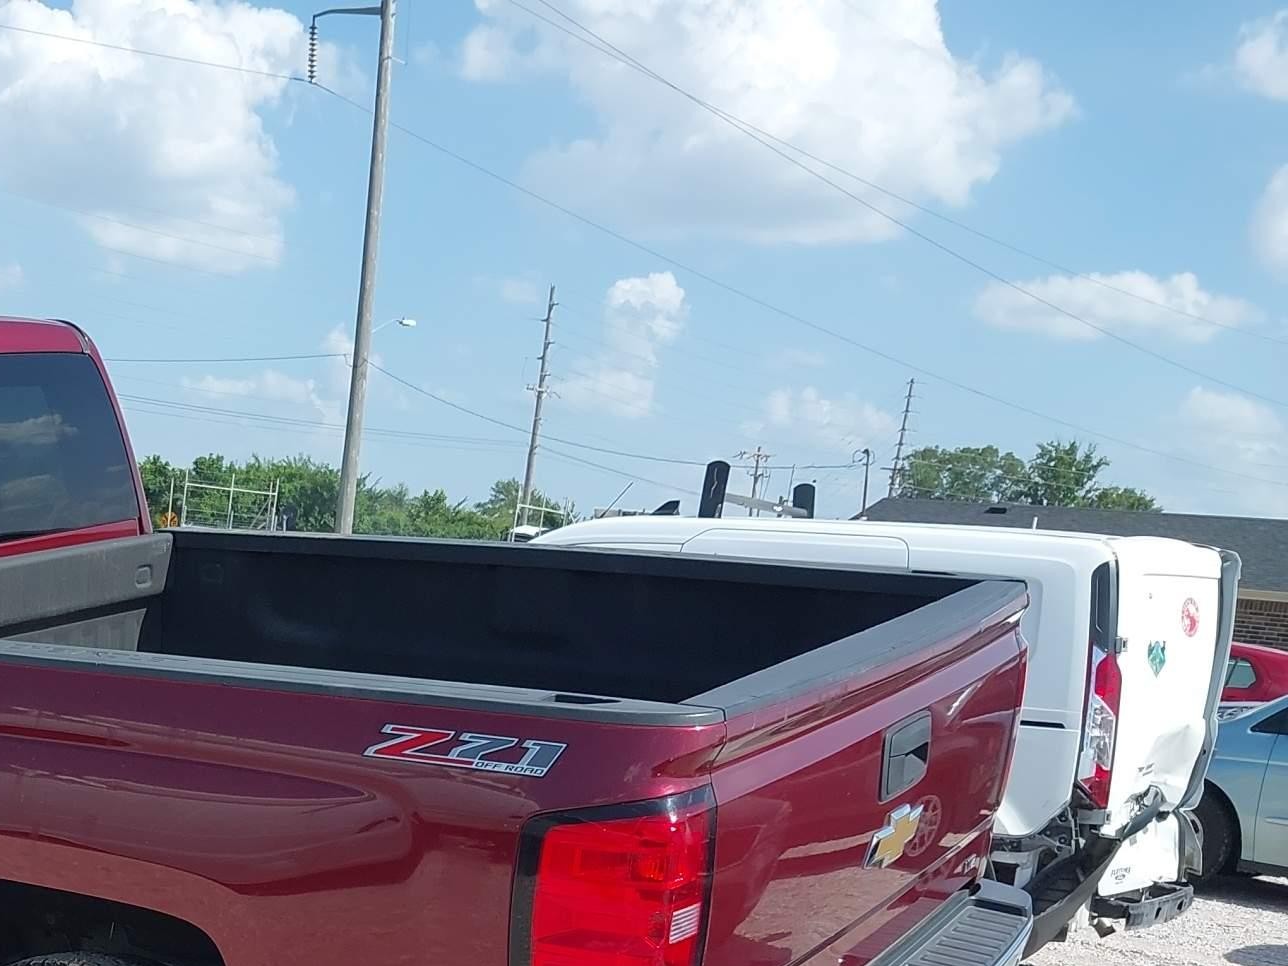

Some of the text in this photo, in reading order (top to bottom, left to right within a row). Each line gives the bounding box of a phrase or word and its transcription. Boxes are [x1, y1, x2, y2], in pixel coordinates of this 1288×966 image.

[363, 724, 568, 773] Z71
[474, 761, 544, 777] OFF ROAD
